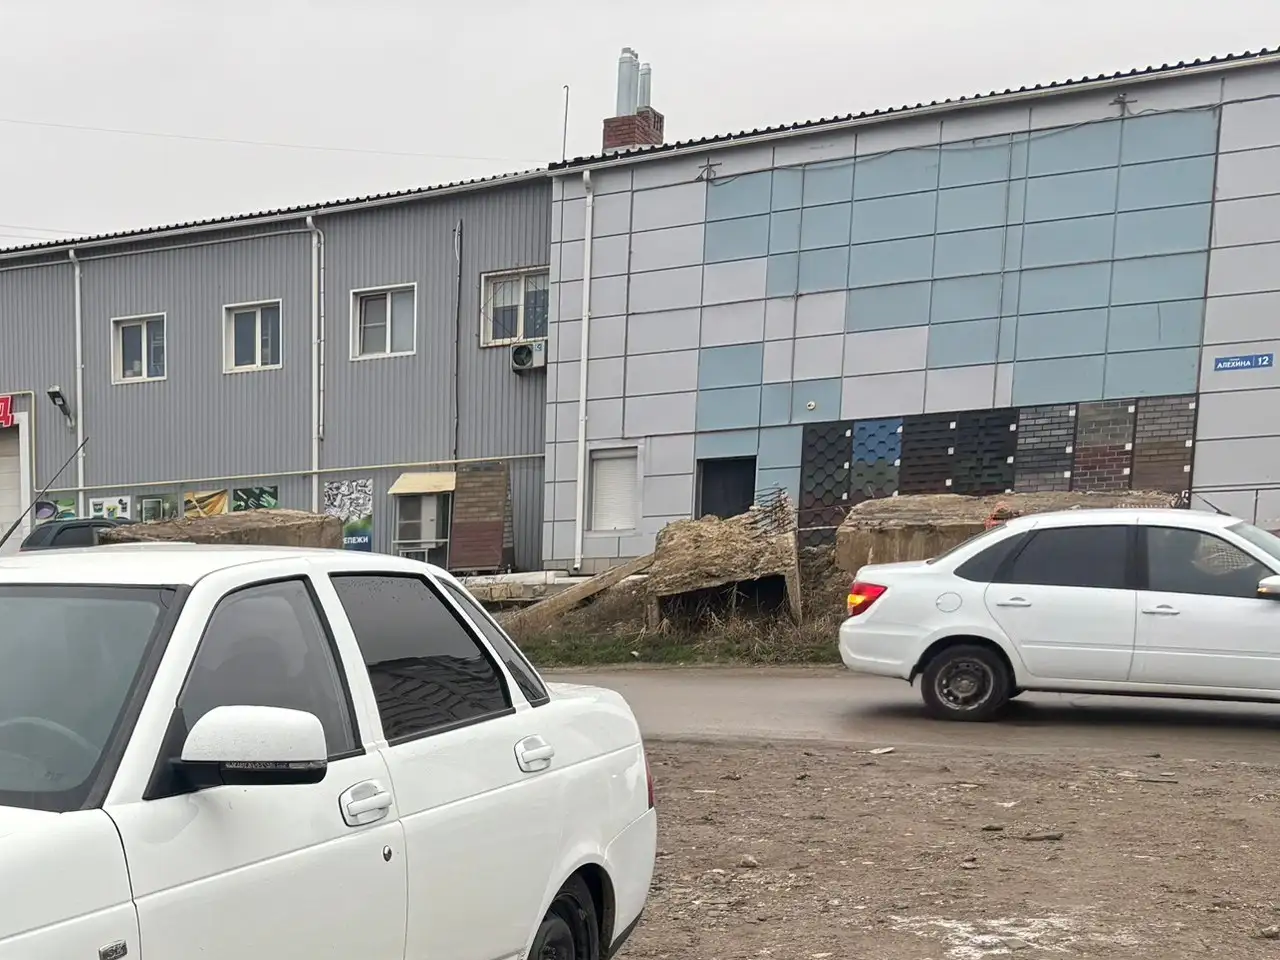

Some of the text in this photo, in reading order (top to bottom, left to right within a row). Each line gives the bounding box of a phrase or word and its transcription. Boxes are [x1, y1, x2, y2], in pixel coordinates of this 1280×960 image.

[1216, 356, 1269, 369] АЛЕХИНА 12
[343, 535, 369, 544] ЕПЕЖИ
